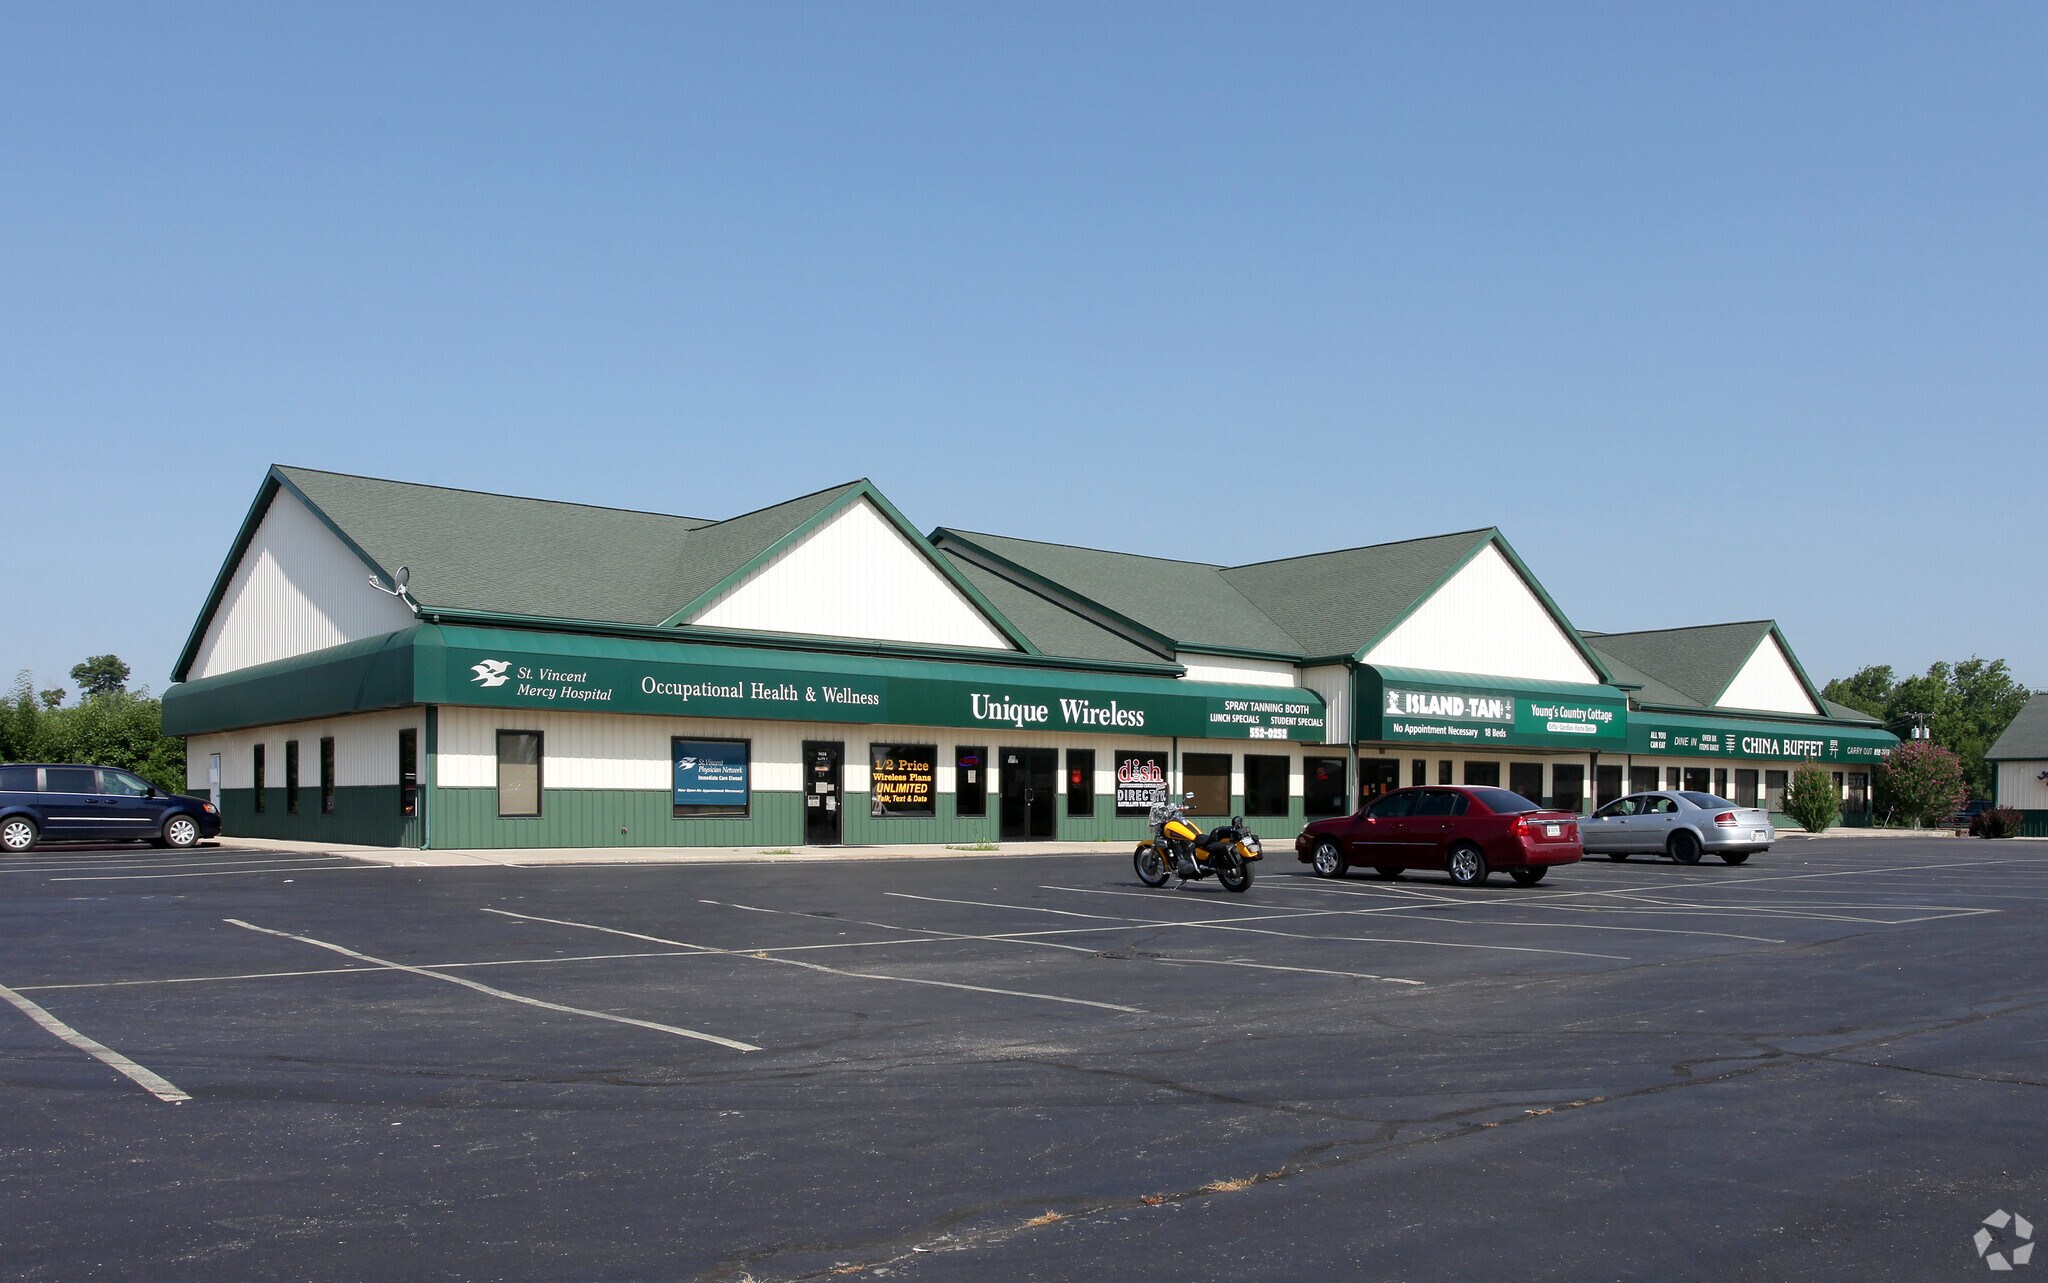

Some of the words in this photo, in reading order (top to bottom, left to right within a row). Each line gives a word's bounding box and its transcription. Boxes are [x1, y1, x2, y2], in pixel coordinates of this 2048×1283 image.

[517, 666, 533, 679] St.
[539, 668, 587, 682] Vincent
[517, 684, 556, 700] Mercy
[560, 686, 612, 701] Hospital
[641, 676, 743, 702] Occupational
[750, 682, 798, 701] Health
[805, 686, 817, 702] &
[822, 686, 880, 705] Wellness
[971, 693, 1048, 727] Unique
[1059, 698, 1145, 727] Wireless
[1225, 700, 1249, 711] SPRAY
[1250, 701, 1283, 713] TANNING
[1285, 704, 1310, 714] BOOTH
[1405, 693, 1464, 716] ISLAND
[1468, 697, 1501, 718] TAN
[1210, 713, 1231, 723] LUNCH
[1232, 714, 1260, 724] SPECIALS
[1531, 704, 1558, 720] Young's
[1560, 706, 1586, 722] Country
[1587, 708, 1612, 723] Cottage
[1270, 716, 1297, 726] STUDENT
[1298, 717, 1323, 727] SPECIALS
[1393, 723, 1403, 733] No
[1404, 724, 1447, 735] Appointment
[1448, 726, 1478, 738] Necessary
[1484, 728, 1491, 737] 18
[1492, 728, 1506, 738] Beds
[1650, 731, 1658, 739] ALL
[1674, 737, 1689, 746] DINE
[1691, 738, 1698, 746] IN
[1742, 736, 1779, 755] CHINA
[1783, 739, 1824, 757] BUFFET
[1847, 746, 1863, 755] CARRY
[1863, 747, 1873, 755] OUT
[698, 766, 721, 775] Physician
[722, 766, 743, 774] Network
[875, 759, 894, 771] 1/2
[898, 760, 929, 771] Price
[1118, 759, 1163, 782] dish
[873, 773, 907, 781] Wireless
[909, 773, 932, 782] Plans
[876, 783, 928, 793] UNLIMITED
